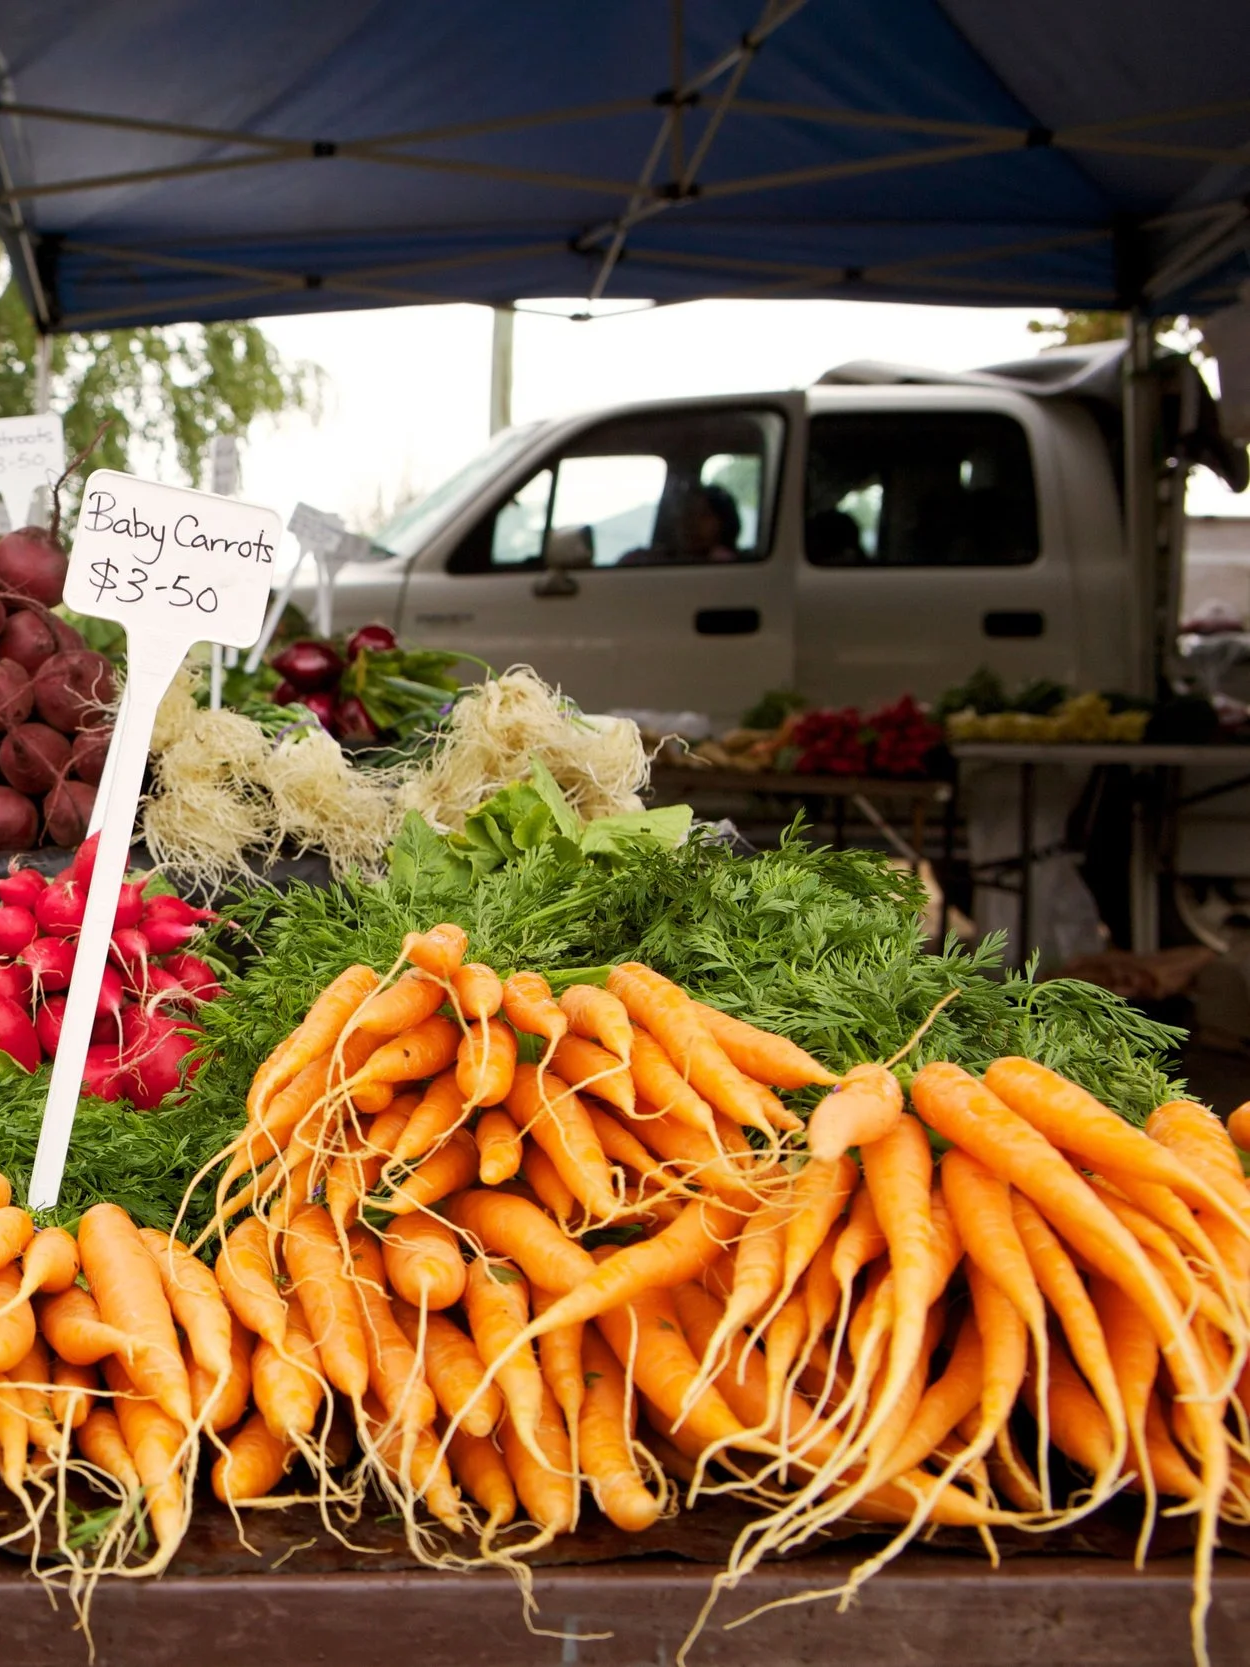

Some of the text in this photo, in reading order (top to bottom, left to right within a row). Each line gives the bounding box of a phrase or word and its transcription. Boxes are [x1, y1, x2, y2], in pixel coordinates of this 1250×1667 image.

[84, 491, 166, 564] Baby
[174, 515, 274, 563] Carrots
[89, 558, 218, 612] $3-50
